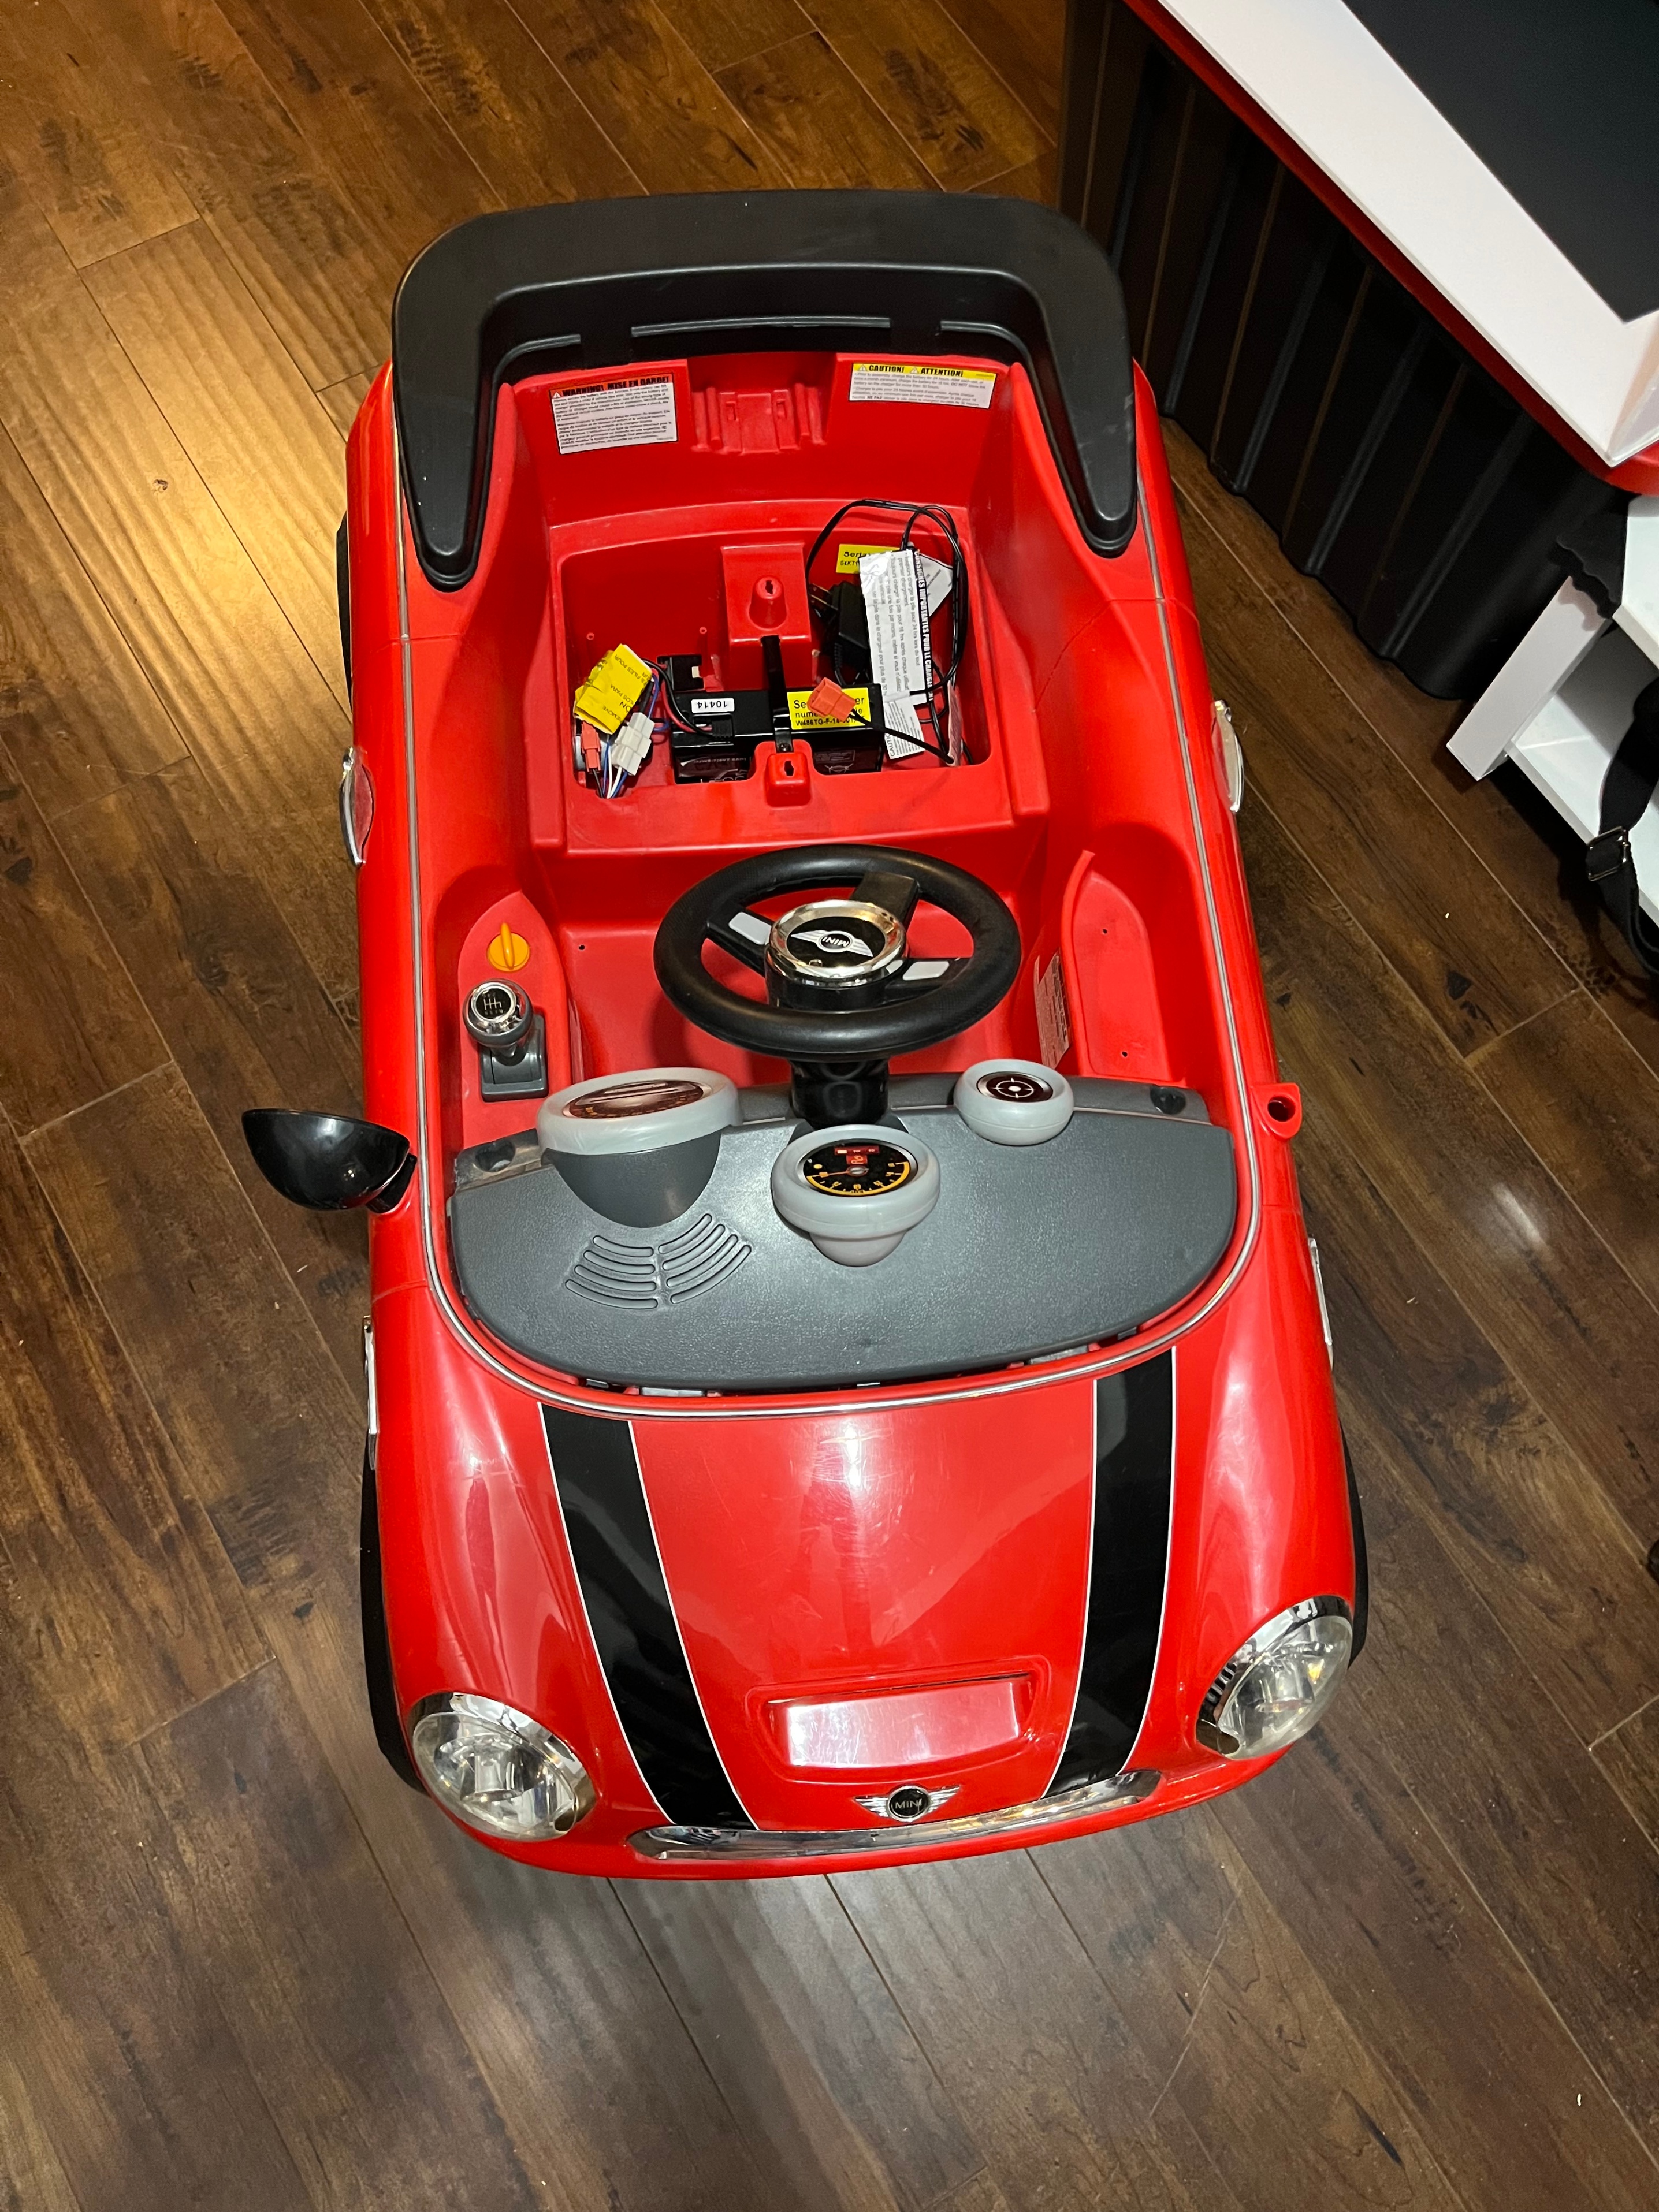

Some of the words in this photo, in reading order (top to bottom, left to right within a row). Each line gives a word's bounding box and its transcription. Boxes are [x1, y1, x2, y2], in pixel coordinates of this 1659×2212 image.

[869, 364, 905, 373] CAUTION!
[920, 368, 964, 377] ATTENTION!
[562, 385, 604, 396] WARNING!
[607, 381, 628, 390] MISE
[628, 379, 639, 388] EN
[918, 587, 929, 634] IMPORTANTES
[697, 700, 728, 709] 10414
[821, 936, 850, 947] MINI
[895, 1798, 923, 1809] MINI
